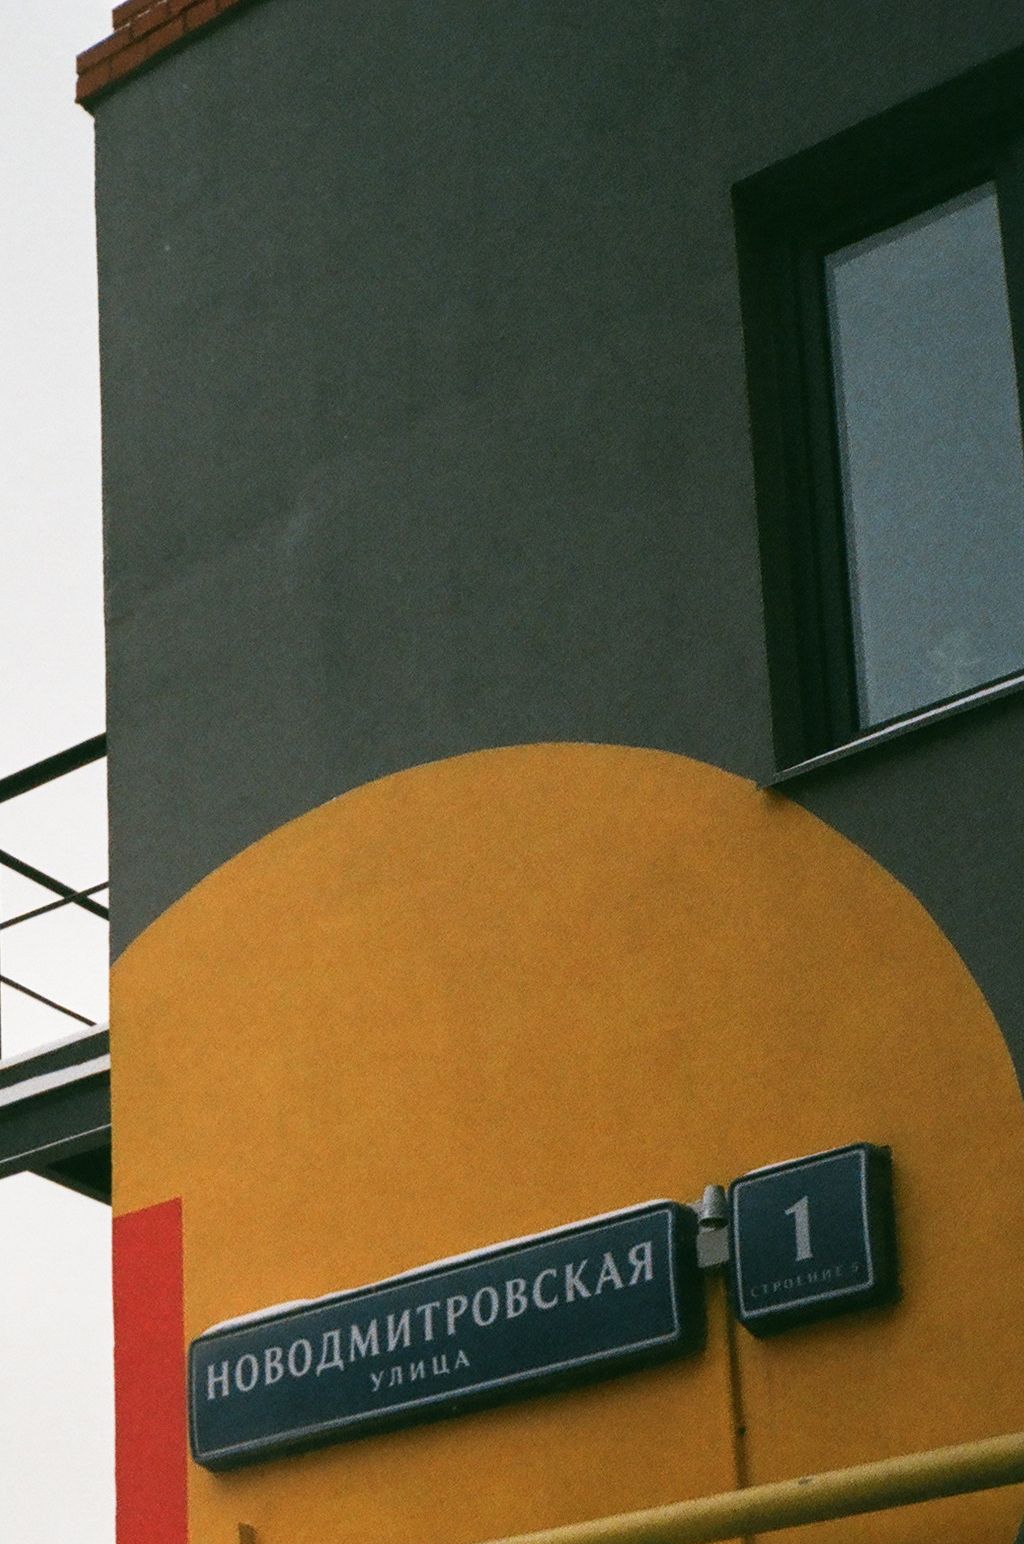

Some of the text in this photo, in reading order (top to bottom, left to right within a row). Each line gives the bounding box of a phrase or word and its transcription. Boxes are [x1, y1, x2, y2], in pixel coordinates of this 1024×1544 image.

[784, 1195, 813, 1262] 1
[207, 1241, 654, 1399] НОВОДМИТРОВСКАЯ
[371, 1350, 470, 1392] УЛИЦА
